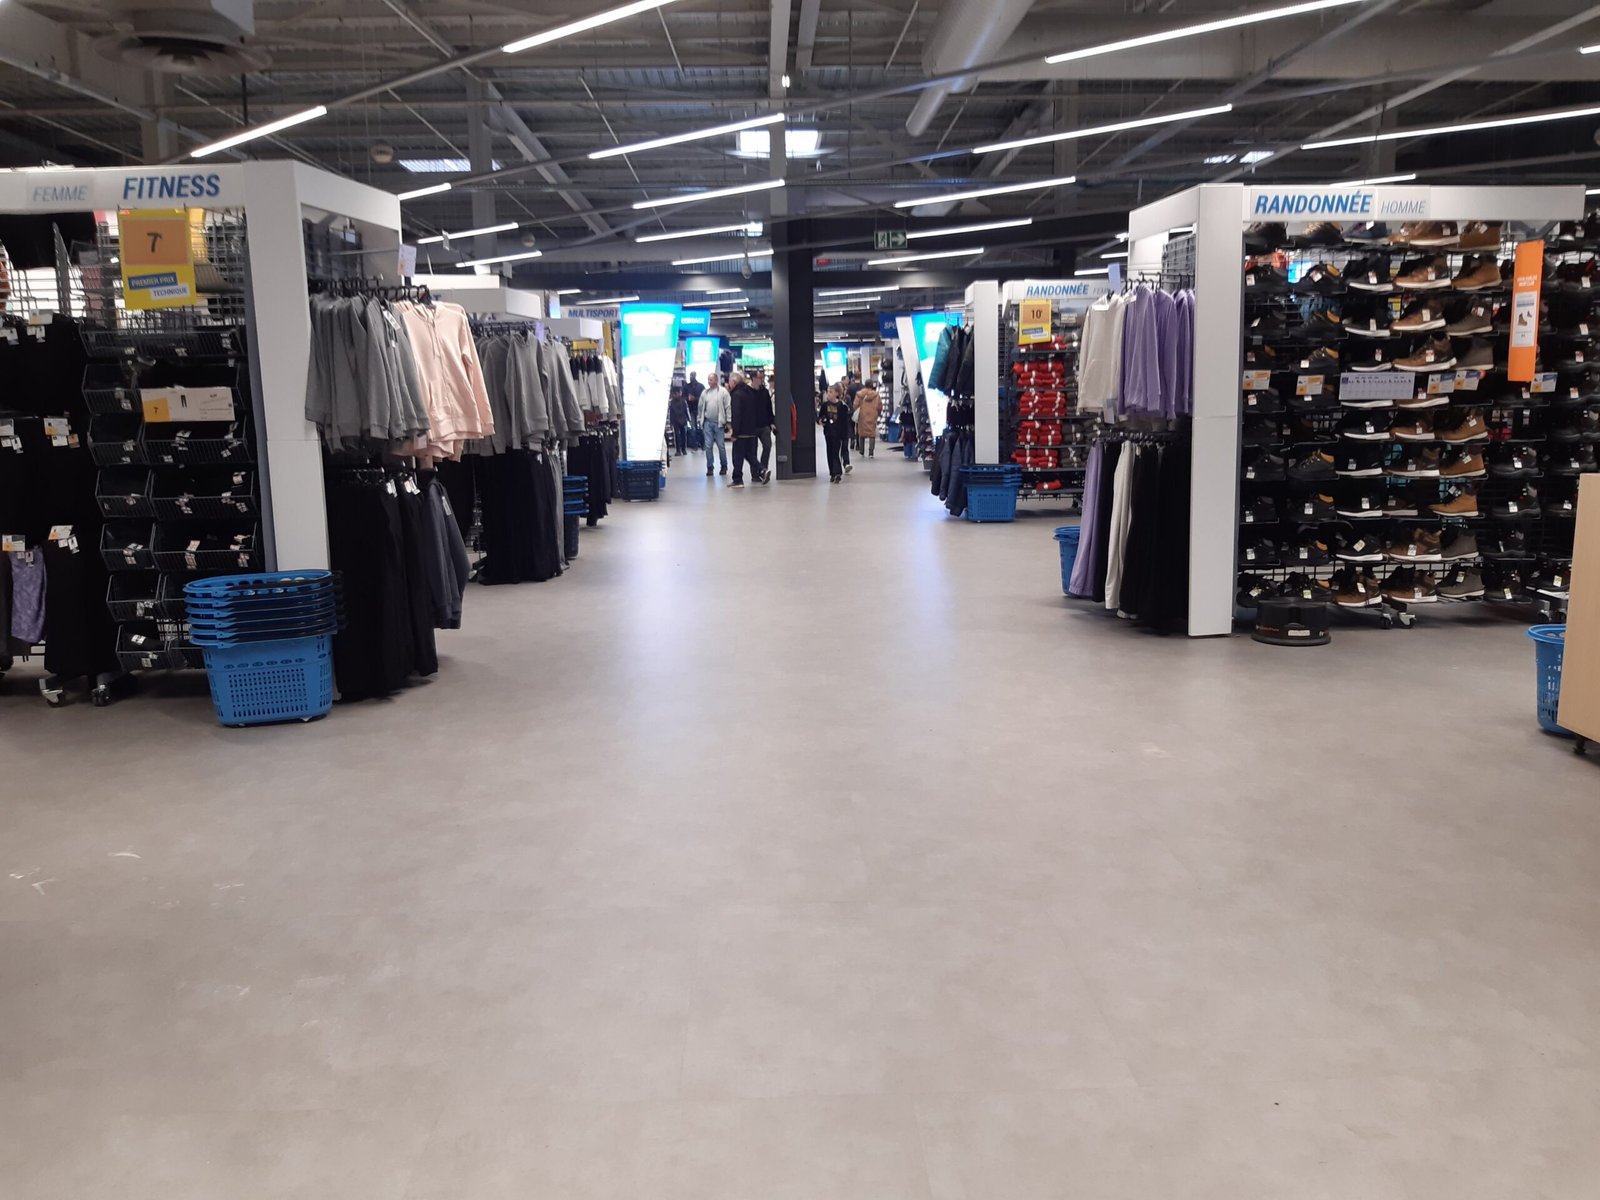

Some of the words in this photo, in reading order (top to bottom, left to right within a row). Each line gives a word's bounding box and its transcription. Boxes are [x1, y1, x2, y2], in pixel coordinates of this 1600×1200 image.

[33, 185, 88, 201] FEMME
[123, 174, 221, 200] FITNESS
[1254, 190, 1373, 214] RANDONNÉE
[1381, 200, 1426, 214] HOMME
[153, 286, 188, 297] TECHNIQUE
[1026, 282, 1090, 296] RANDONNÉE
[568, 308, 619, 318] MULTISPORT
